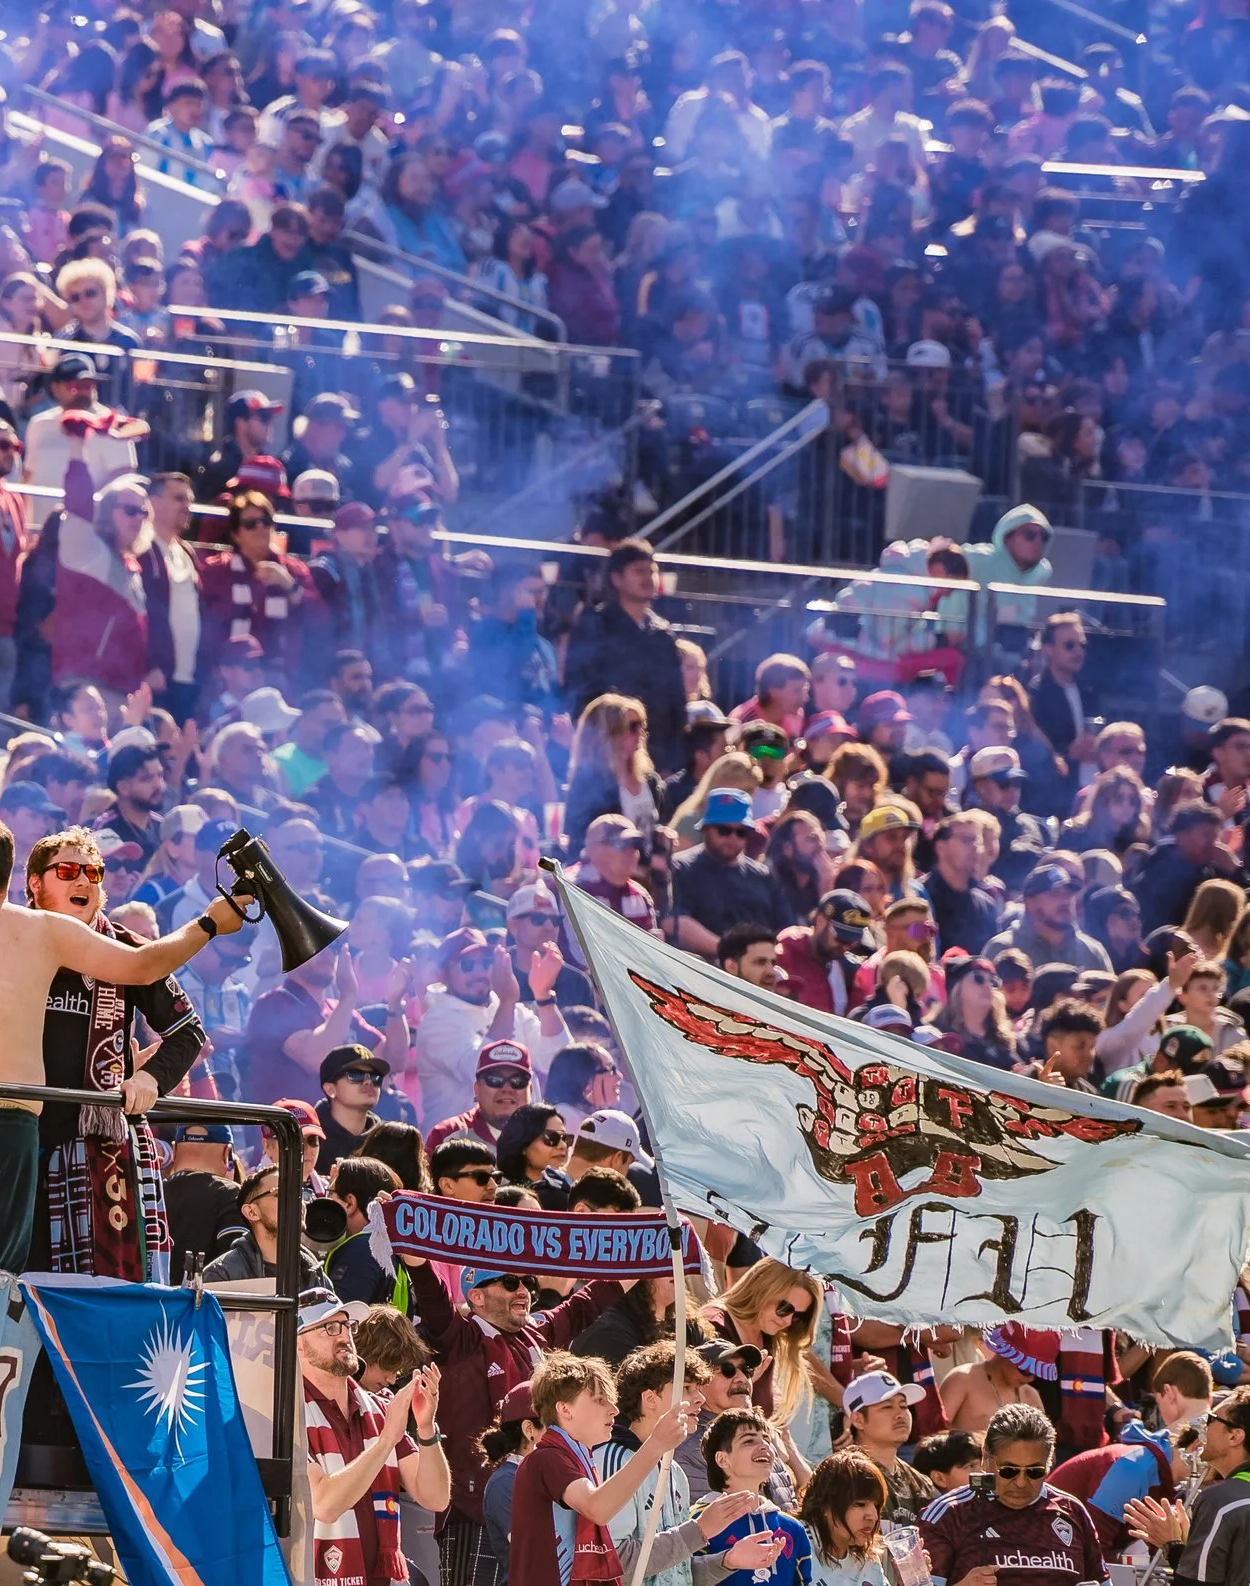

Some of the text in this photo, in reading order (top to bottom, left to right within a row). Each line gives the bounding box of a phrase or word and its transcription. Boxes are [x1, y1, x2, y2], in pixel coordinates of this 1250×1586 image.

[46, 990, 90, 1015] ealth
[94, 986, 116, 1031] HOME
[395, 1202, 690, 1263] COLORADO VS EVERYBOY
[995, 1549, 1076, 1572] uchealth
[340, 1575, 364, 1586] TICKET
